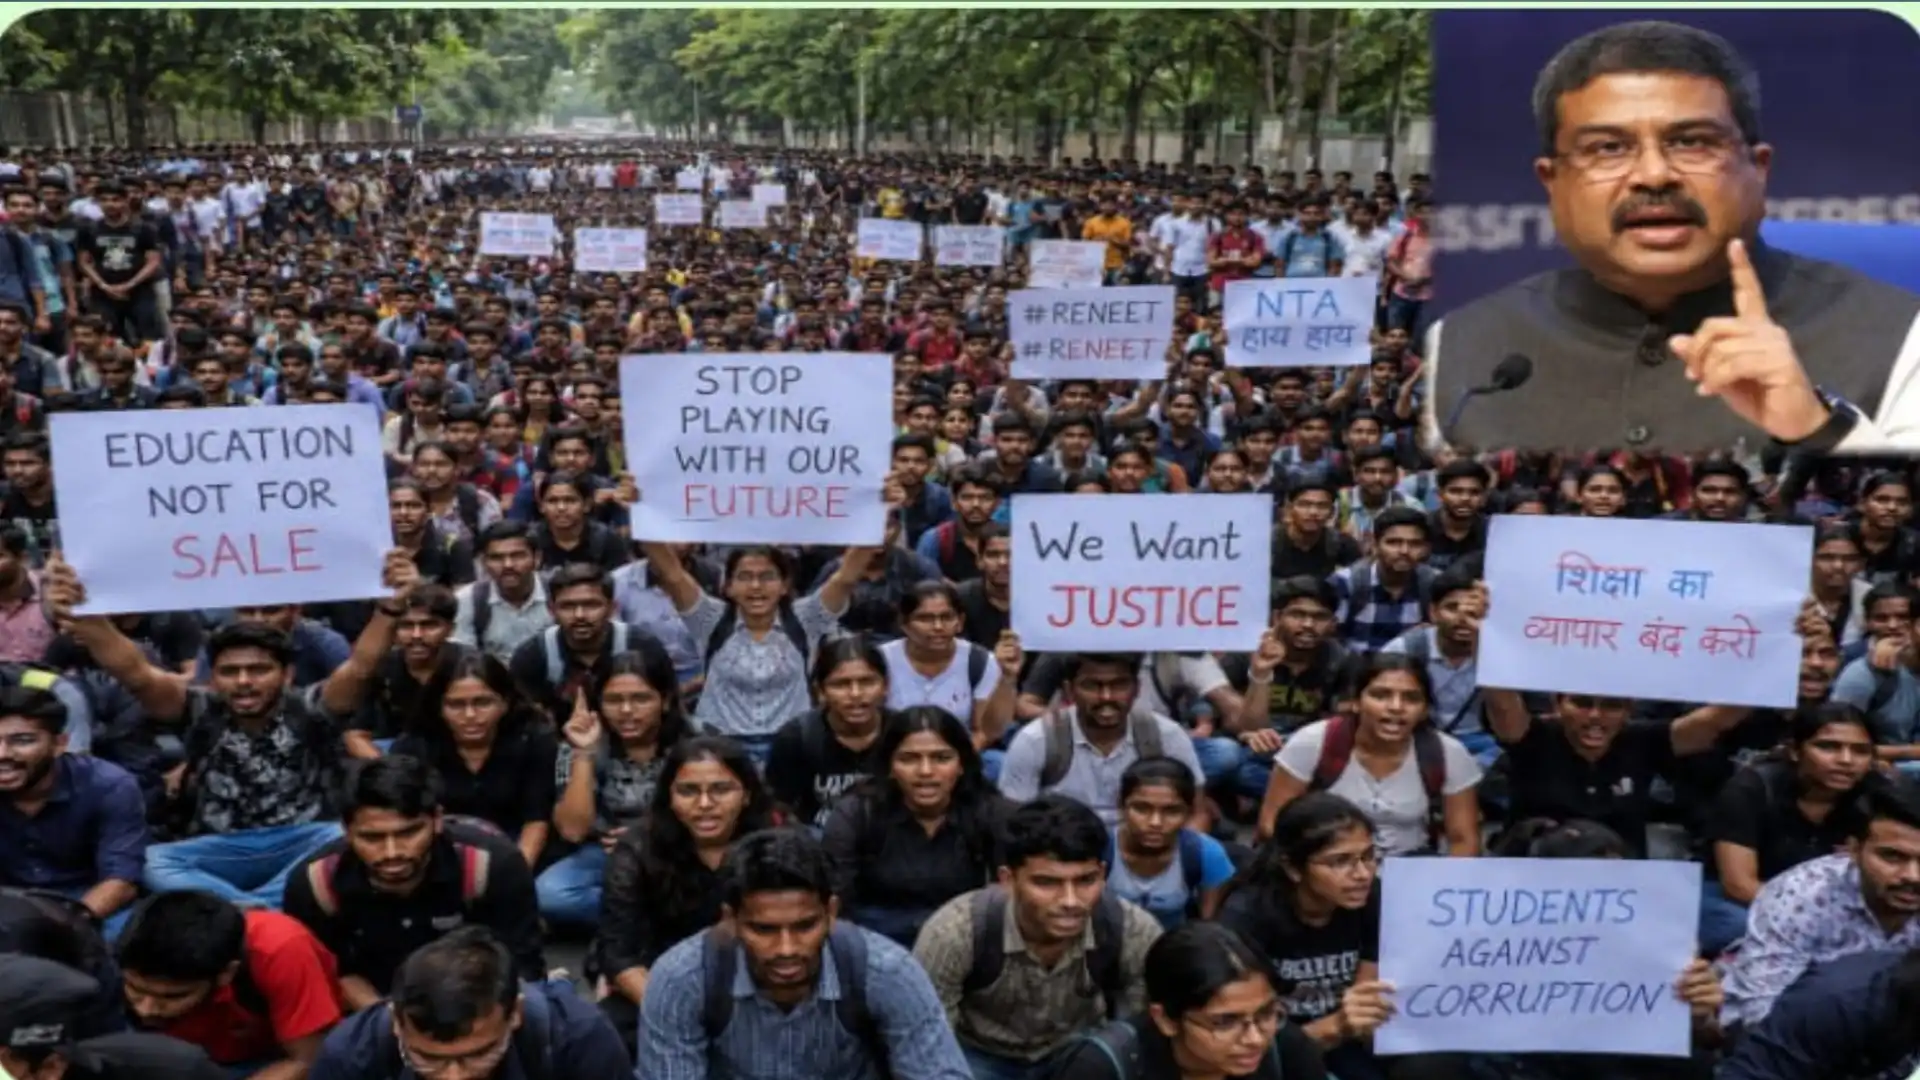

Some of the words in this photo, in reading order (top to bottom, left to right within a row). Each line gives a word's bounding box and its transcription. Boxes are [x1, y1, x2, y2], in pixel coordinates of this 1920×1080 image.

[1023, 300, 1162, 325] #RENEET
[1256, 289, 1340, 318] NTA
[1022, 338, 1155, 362] #RENEET
[1240, 325, 1292, 351] हाय
[1306, 324, 1357, 351] हाय
[695, 365, 803, 396] STOP
[680, 404, 830, 435] PLAYING
[104, 424, 355, 469] EDUCATION
[674, 445, 767, 474] WITH
[787, 444, 862, 476] OUR
[147, 483, 233, 517] NOT
[257, 477, 337, 513] FOR
[684, 484, 849, 522] FUTURE
[172, 528, 321, 579] SALE
[1030, 521, 1104, 562] We
[1130, 520, 1241, 562] Want
[1556, 551, 1647, 598] शिक्षा
[1668, 569, 1714, 600] का
[1047, 584, 1242, 629] JUSTICE
[1523, 615, 1624, 651] व्यापार
[1638, 615, 1688, 658] बंद
[1699, 613, 1762, 659] करो
[1428, 888, 1637, 927] STUDENTS
[1441, 936, 1600, 968] AGAINST
[1404, 981, 1667, 1018] CORRUPTION
